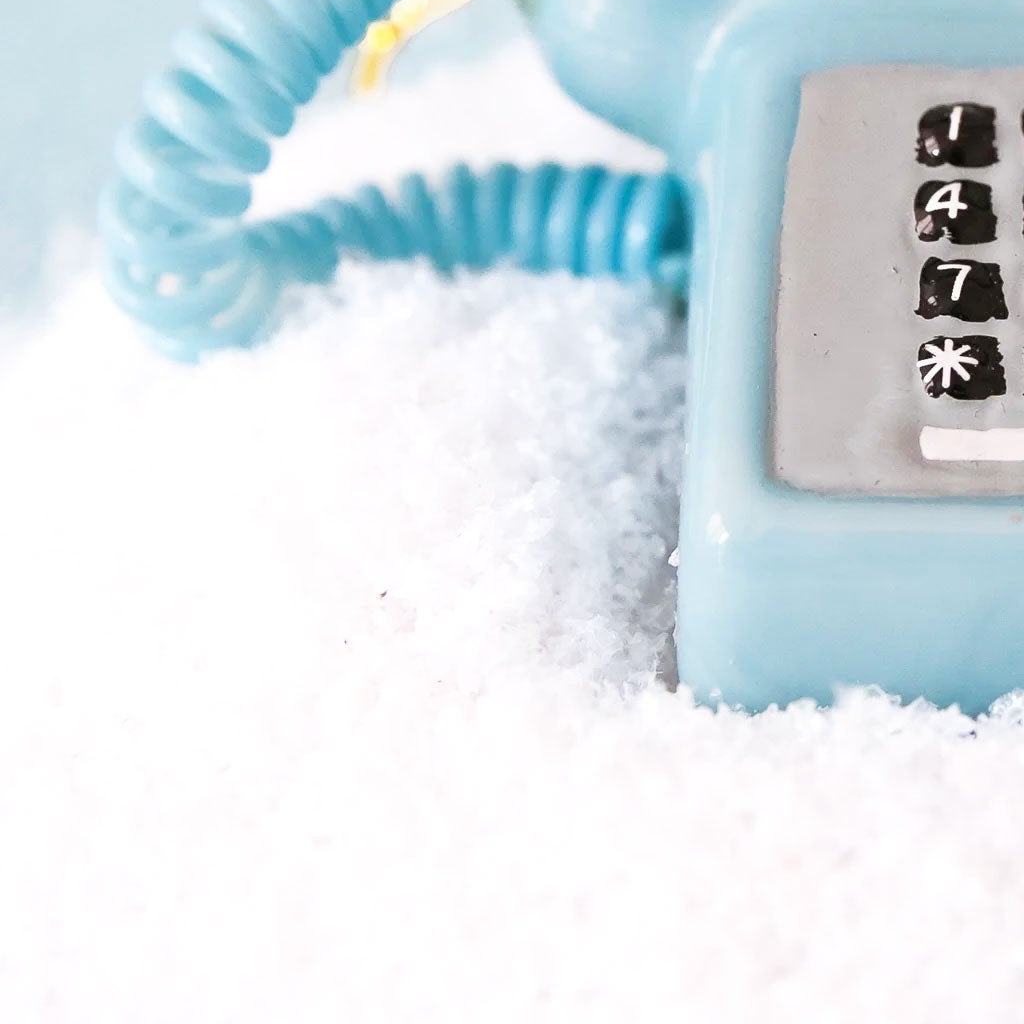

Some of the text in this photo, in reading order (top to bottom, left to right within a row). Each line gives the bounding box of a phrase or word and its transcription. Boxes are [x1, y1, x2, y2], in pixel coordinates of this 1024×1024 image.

[948, 106, 963, 141] 1
[925, 182, 968, 219] 4
[936, 263, 972, 301] 7
